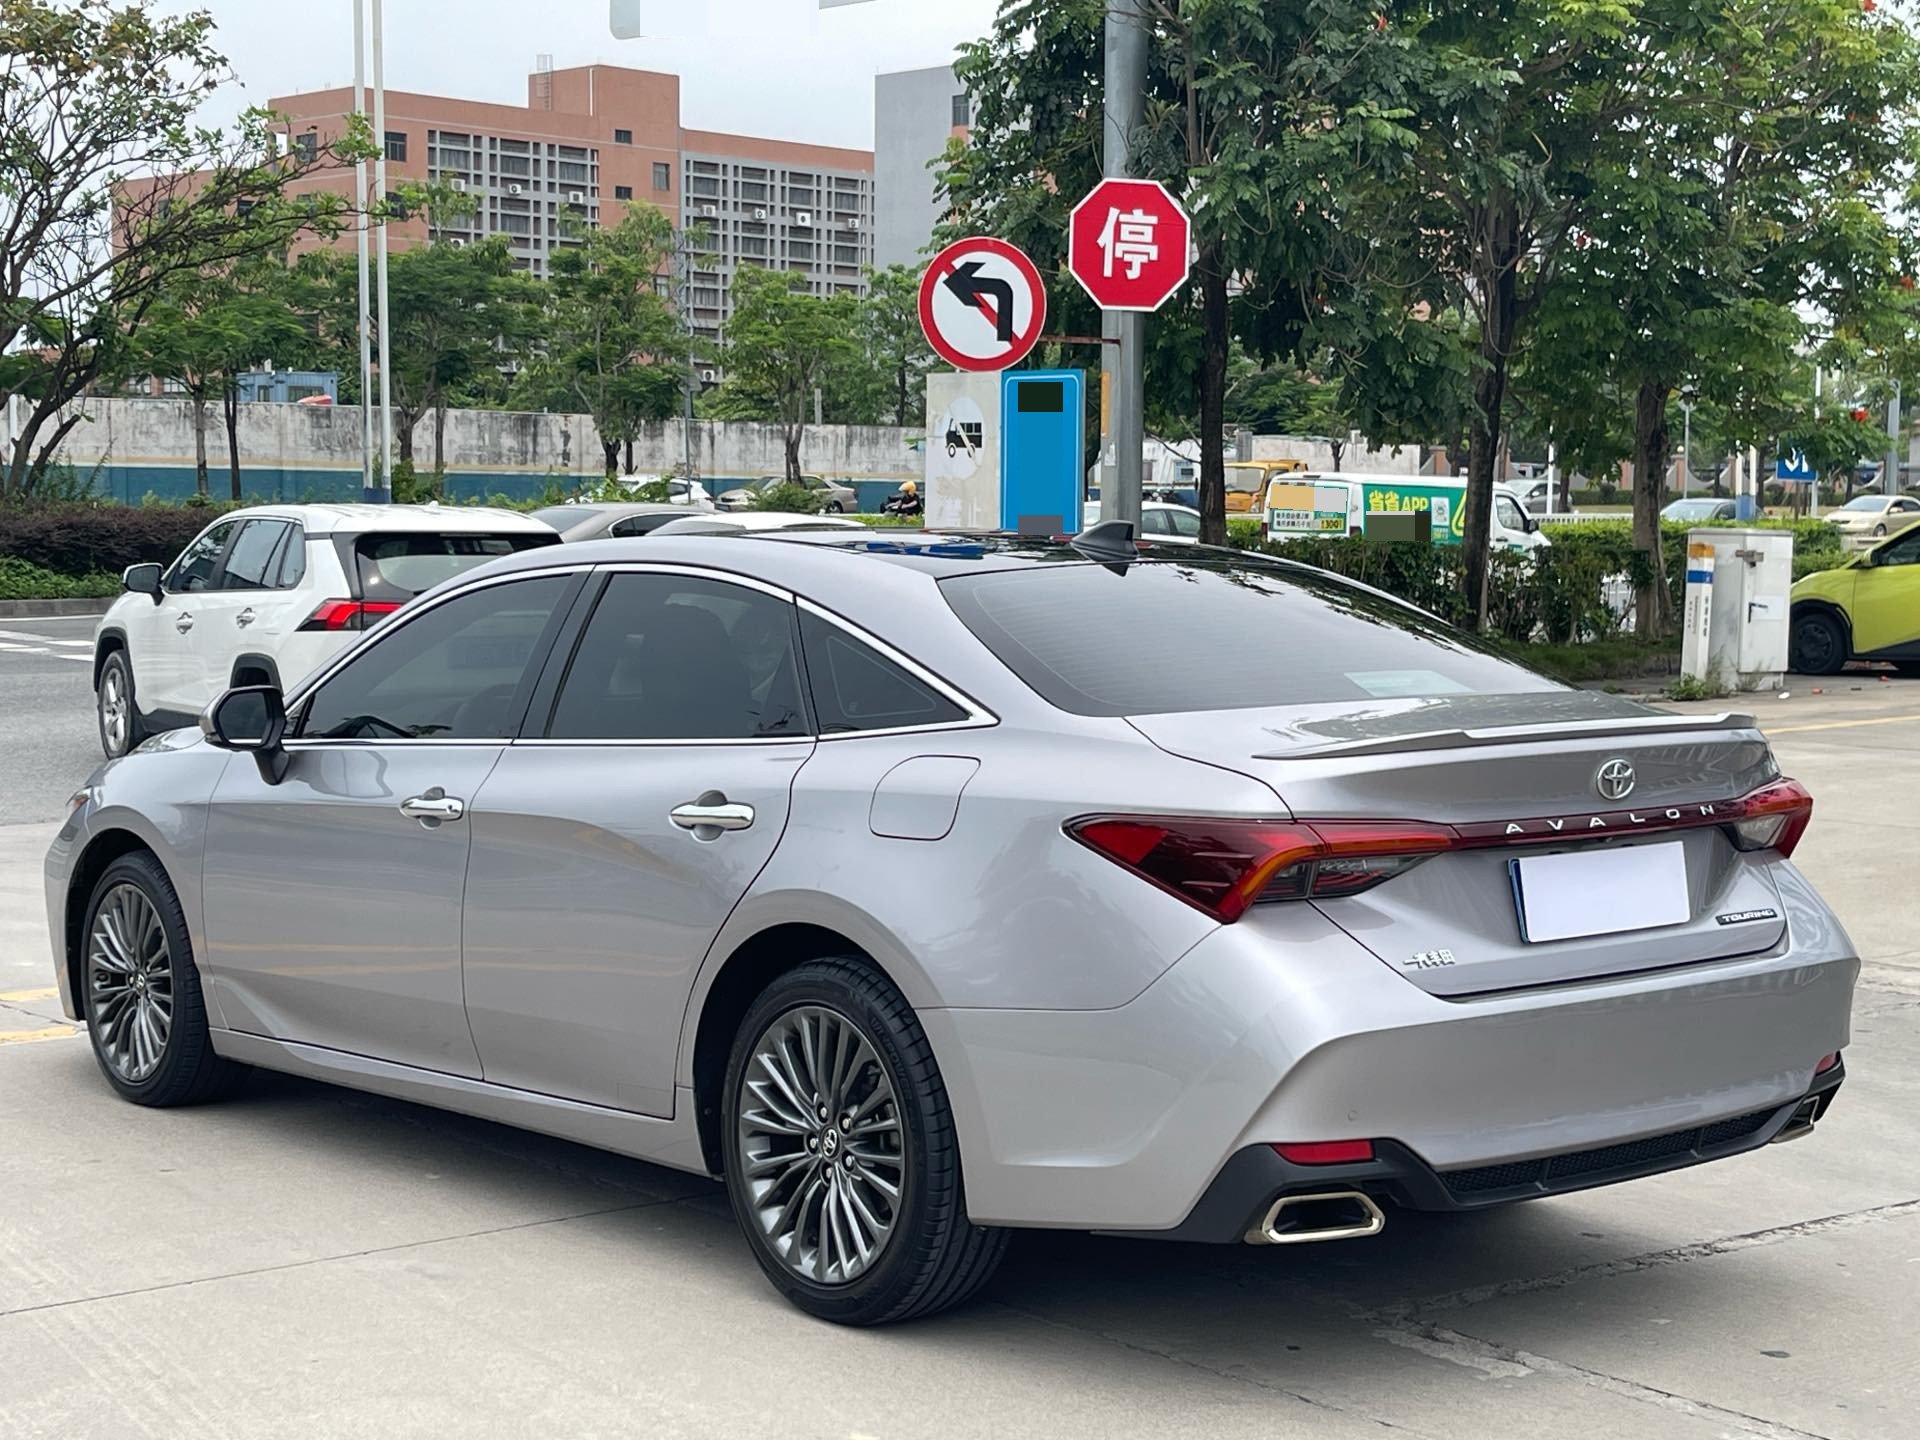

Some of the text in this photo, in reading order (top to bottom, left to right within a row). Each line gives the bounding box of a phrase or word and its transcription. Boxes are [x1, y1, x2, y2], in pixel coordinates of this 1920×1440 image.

[1097, 206, 1159, 280] 停
[1506, 804, 1714, 835] AVALON
[1721, 909, 1774, 922] TOURING
